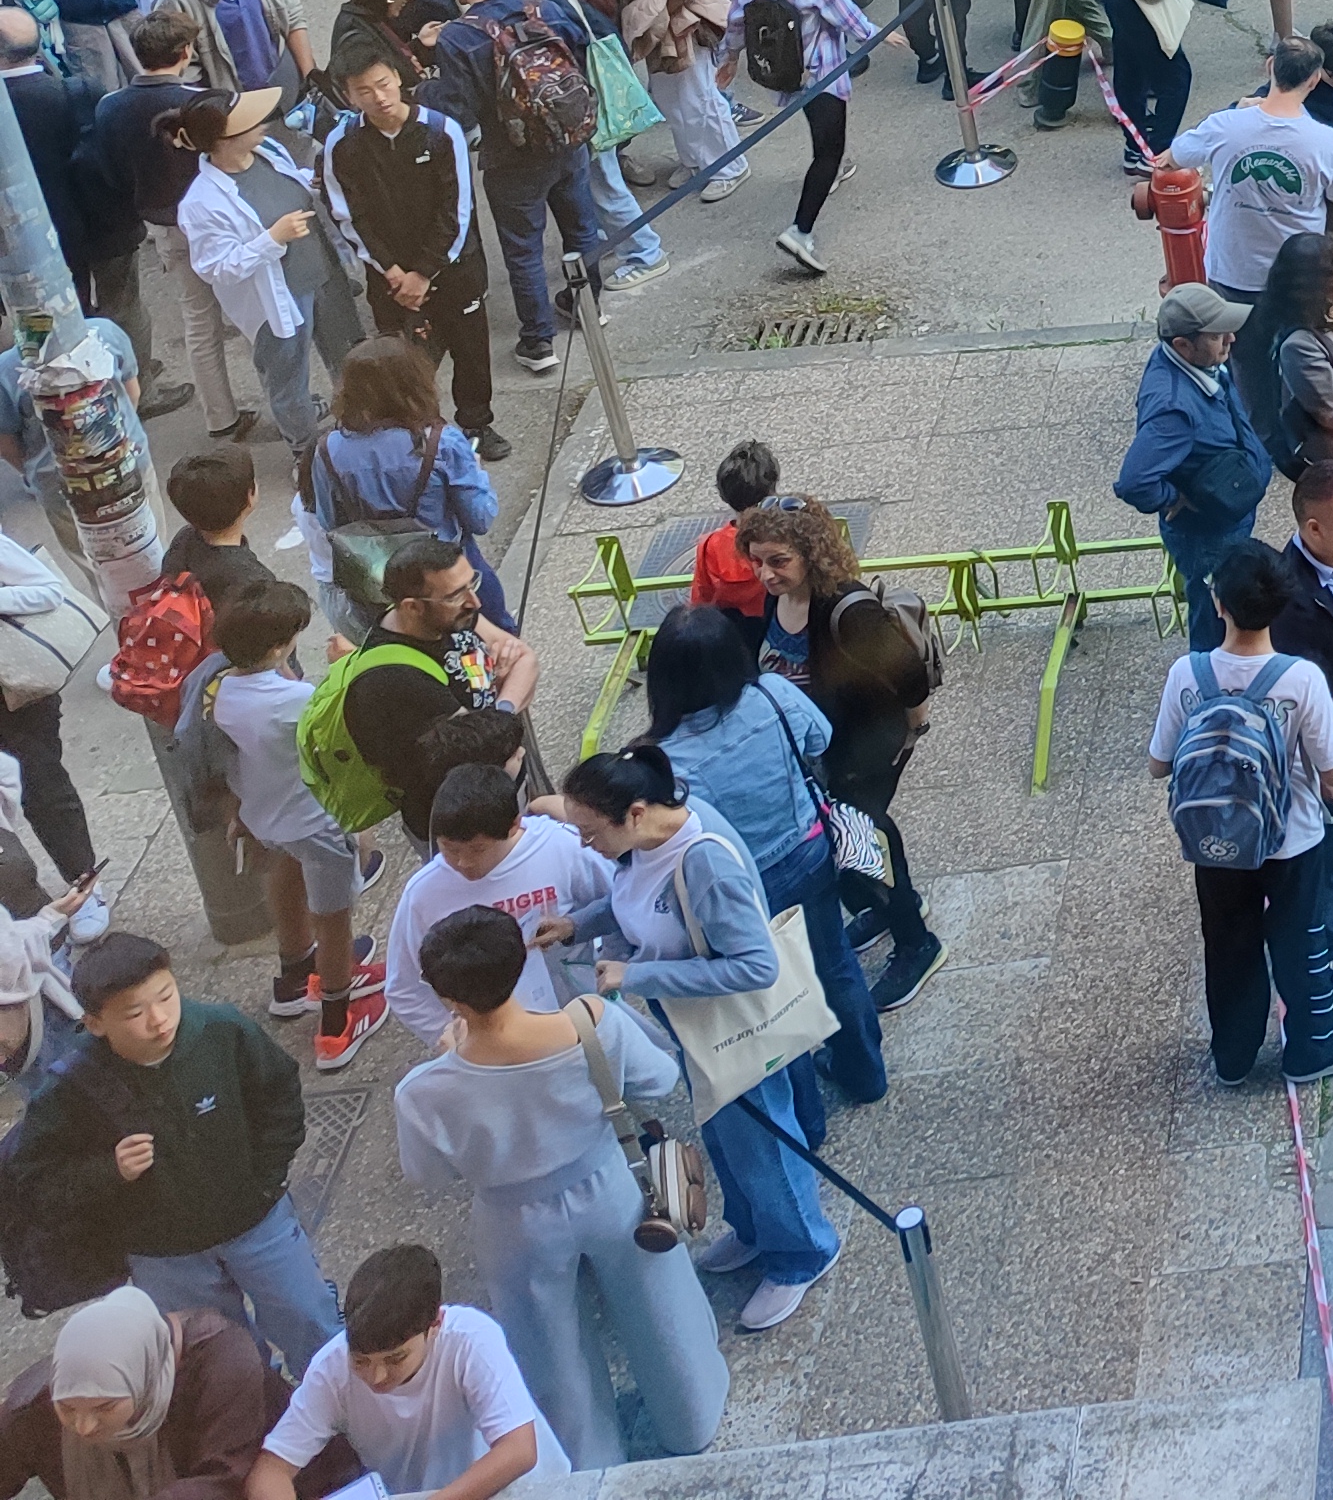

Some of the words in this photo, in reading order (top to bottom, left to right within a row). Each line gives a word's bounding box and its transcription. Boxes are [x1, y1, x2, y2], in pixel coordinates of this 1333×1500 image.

[1240, 156, 1298, 183] Remarkable
[712, 1036, 736, 1054] THE
[735, 1026, 756, 1042] JOY
[755, 1020, 770, 1033] OF
[769, 987, 810, 1025] SHOPPING
